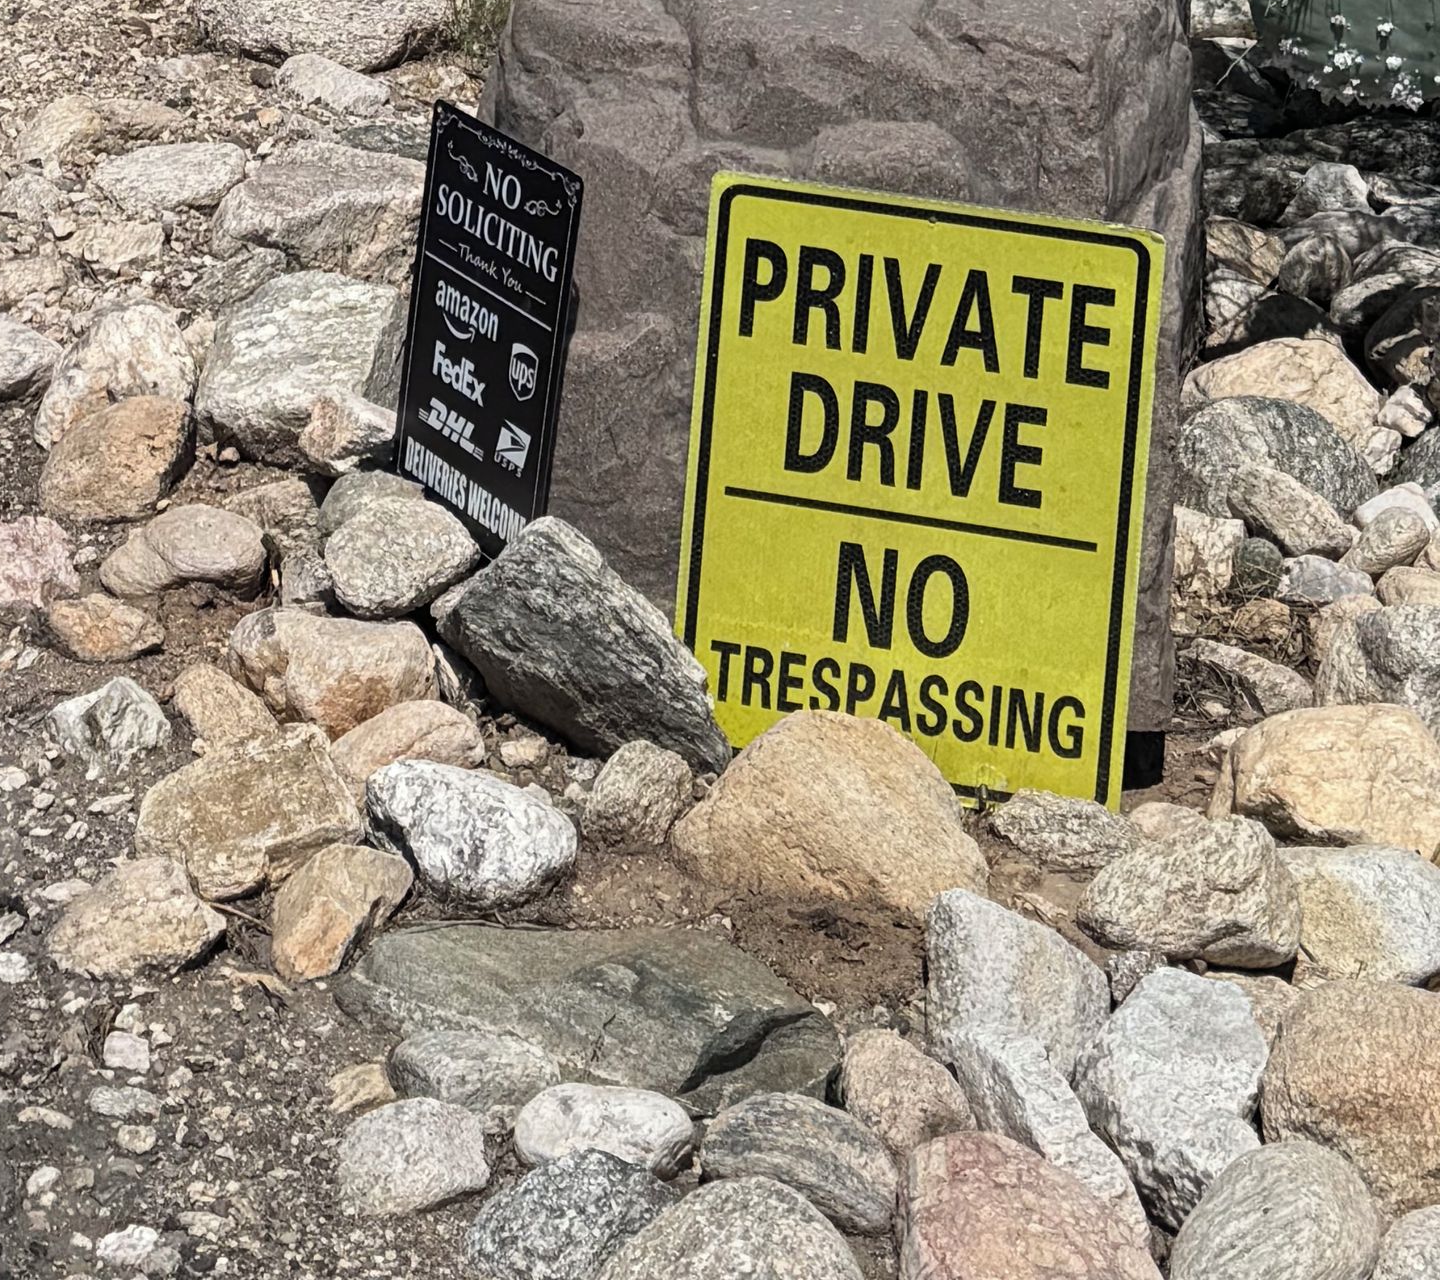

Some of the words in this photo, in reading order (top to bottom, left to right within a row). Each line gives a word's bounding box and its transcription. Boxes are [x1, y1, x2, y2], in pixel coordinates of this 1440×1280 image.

[483, 161, 521, 210] NO
[436, 183, 558, 283] SOLICITING
[458, 242, 498, 279] Thank
[502, 266, 522, 293] You
[435, 280, 499, 342] amazon
[739, 237, 1116, 389] PRIVATE
[432, 340, 486, 407] FedEx
[512, 355, 534, 391] ups
[427, 397, 475, 454] DHL
[783, 371, 1048, 509] DRIVE
[494, 453, 522, 478] USPS
[832, 541, 970, 658] NO
[711, 640, 1085, 759] TRESPASSING
